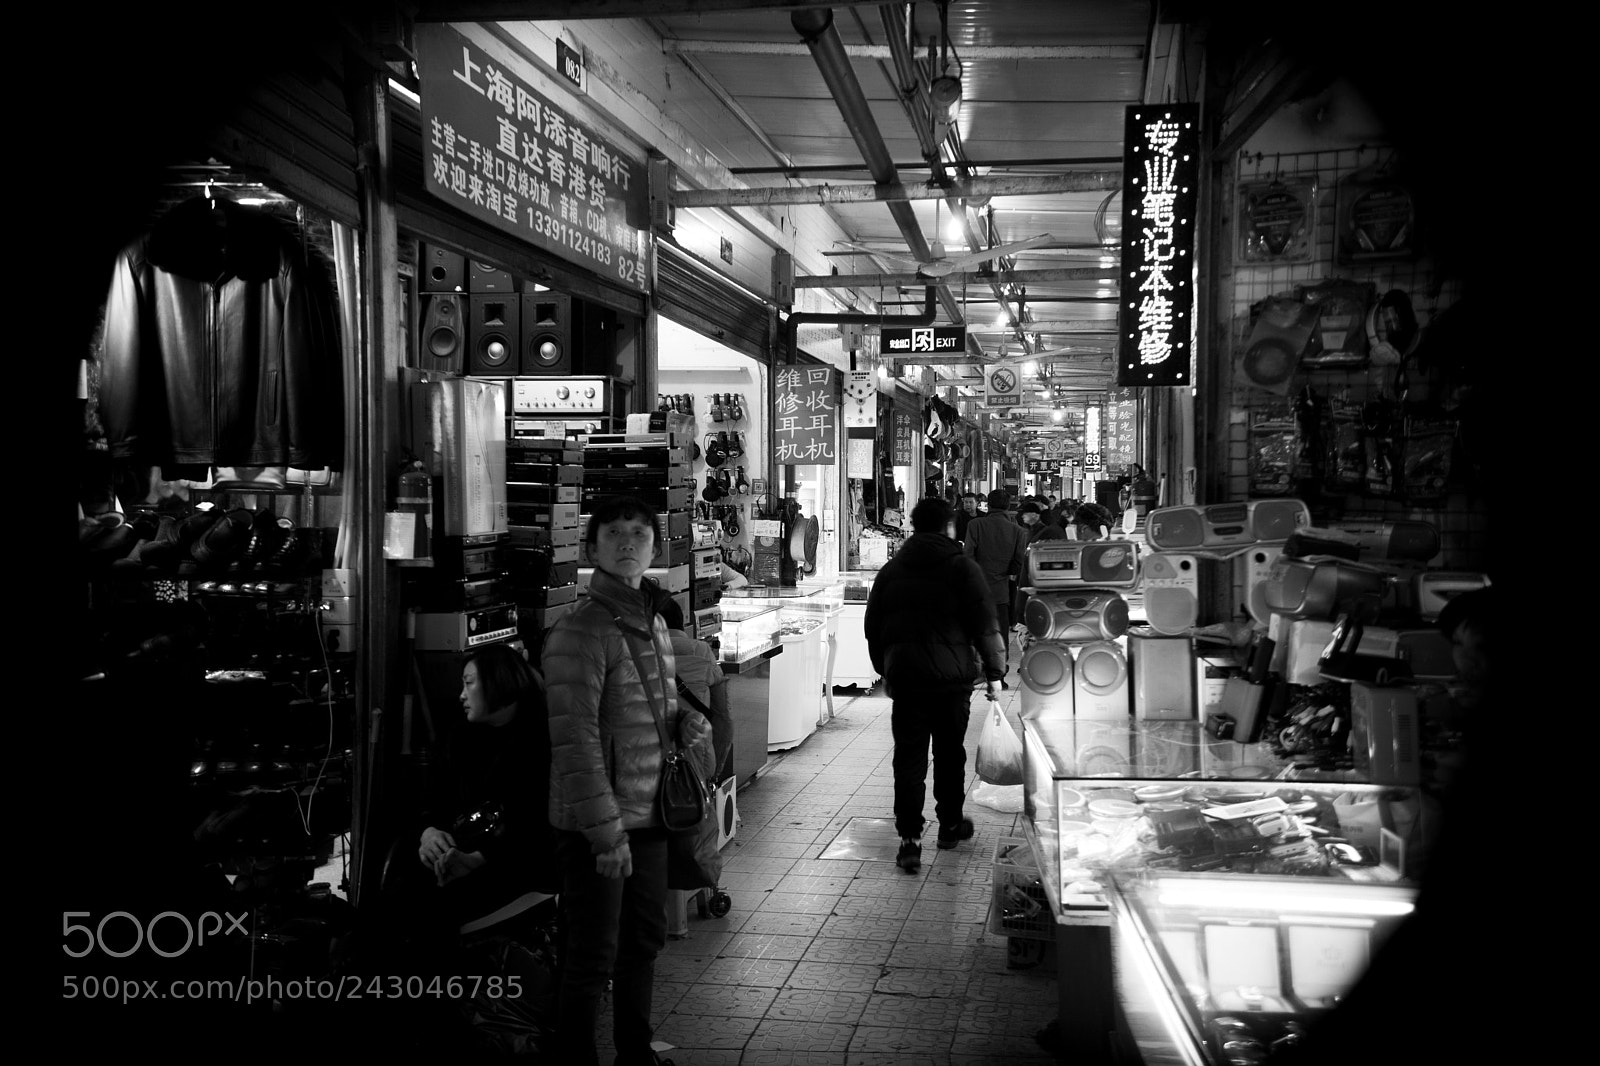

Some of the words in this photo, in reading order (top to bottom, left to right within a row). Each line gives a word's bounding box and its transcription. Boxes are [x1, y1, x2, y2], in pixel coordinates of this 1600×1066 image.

[565, 56, 580, 83] 082
[453, 45, 631, 191] 上海阿添音响行
[496, 115, 607, 211] 直达香港货
[433, 153, 518, 224] 欢迎来淘宝
[527, 206, 611, 266] 13391124183
[618, 256, 647, 291] 82号
[1138, 120, 1179, 365] 专业笔记本维修
[936, 337, 957, 348] EXIT
[775, 368, 804, 462] 维修耳机
[804, 368, 835, 461] 回收耳机
[1085, 454, 1100, 464] 69
[1029, 461, 1059, 470] 开票处
